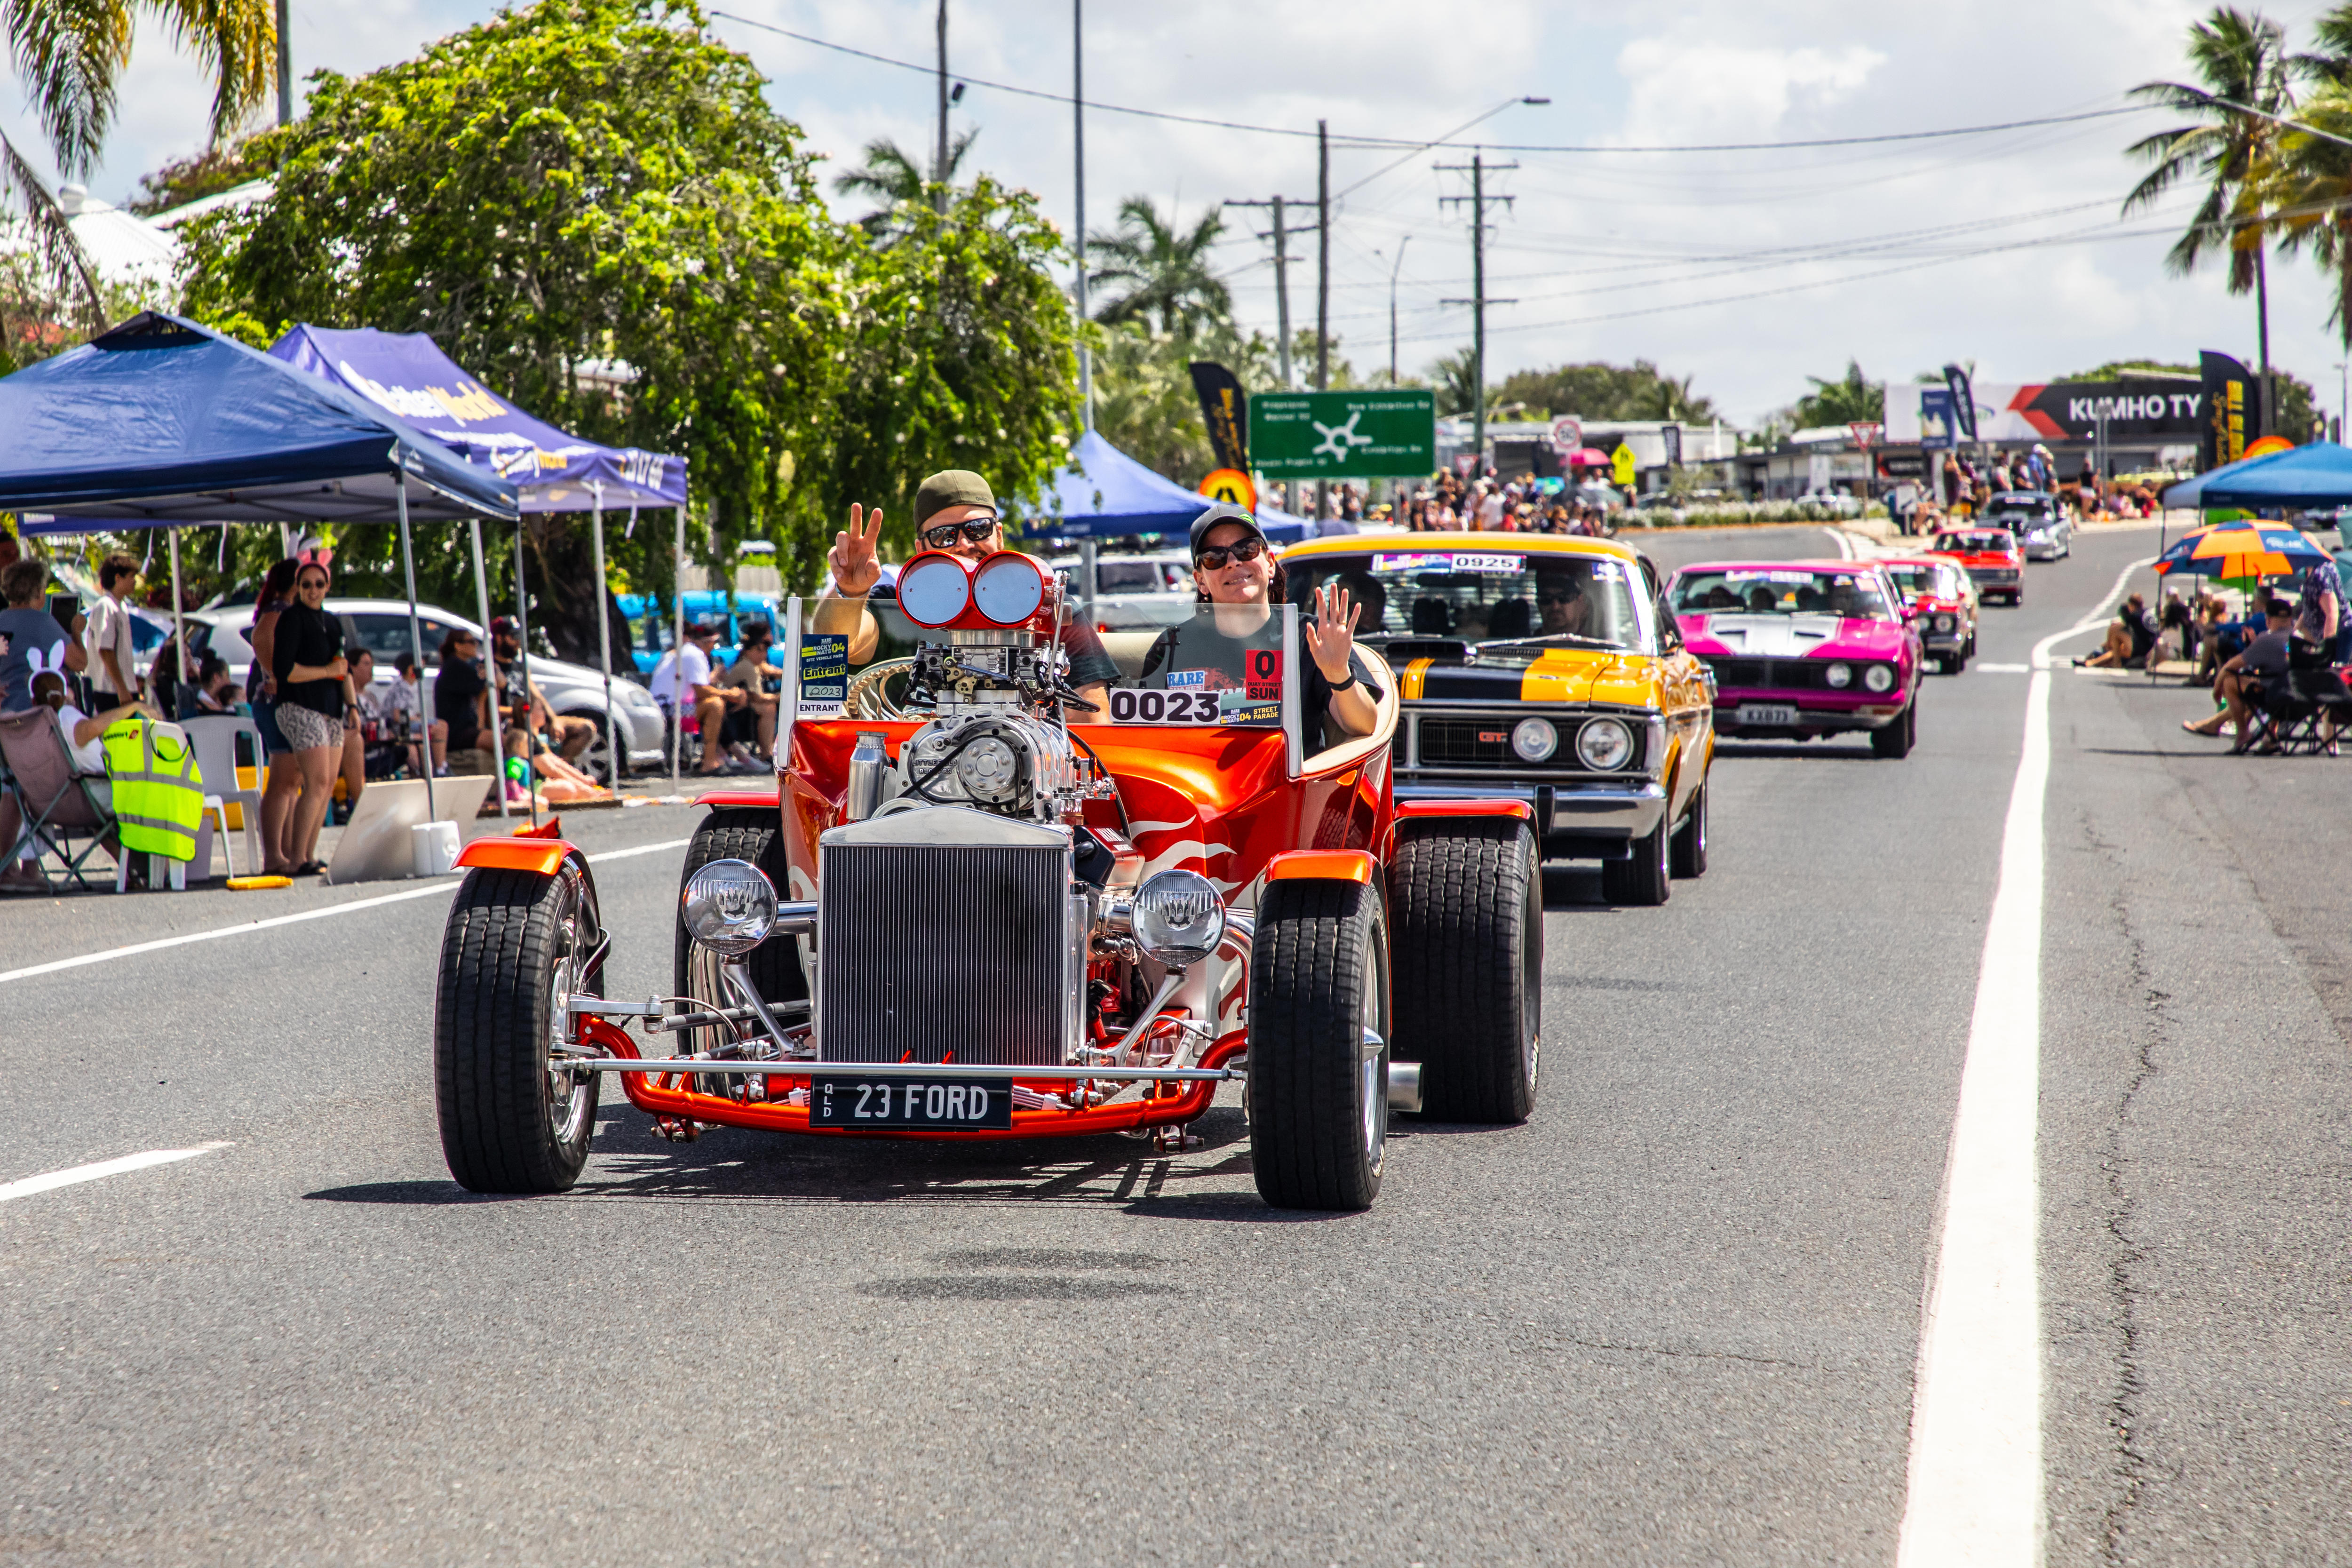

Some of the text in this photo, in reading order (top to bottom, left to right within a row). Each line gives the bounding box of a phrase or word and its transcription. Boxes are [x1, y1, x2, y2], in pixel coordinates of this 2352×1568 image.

[2070, 394, 2166, 421] KUMHO
[1456, 557, 1513, 567] 0925
[832, 643, 845, 653] 04
[804, 664, 845, 679] Entrant
[1168, 672, 1203, 686] RARE
[811, 687, 840, 696] 0023
[1250, 687, 1278, 699] SUN
[1111, 691, 1219, 722] 0023
[1240, 713, 1251, 721] 04
[1479, 732, 1508, 742] GT
[823, 1083, 833, 1117] QLD
[855, 1084, 988, 1119] 23 FORD
